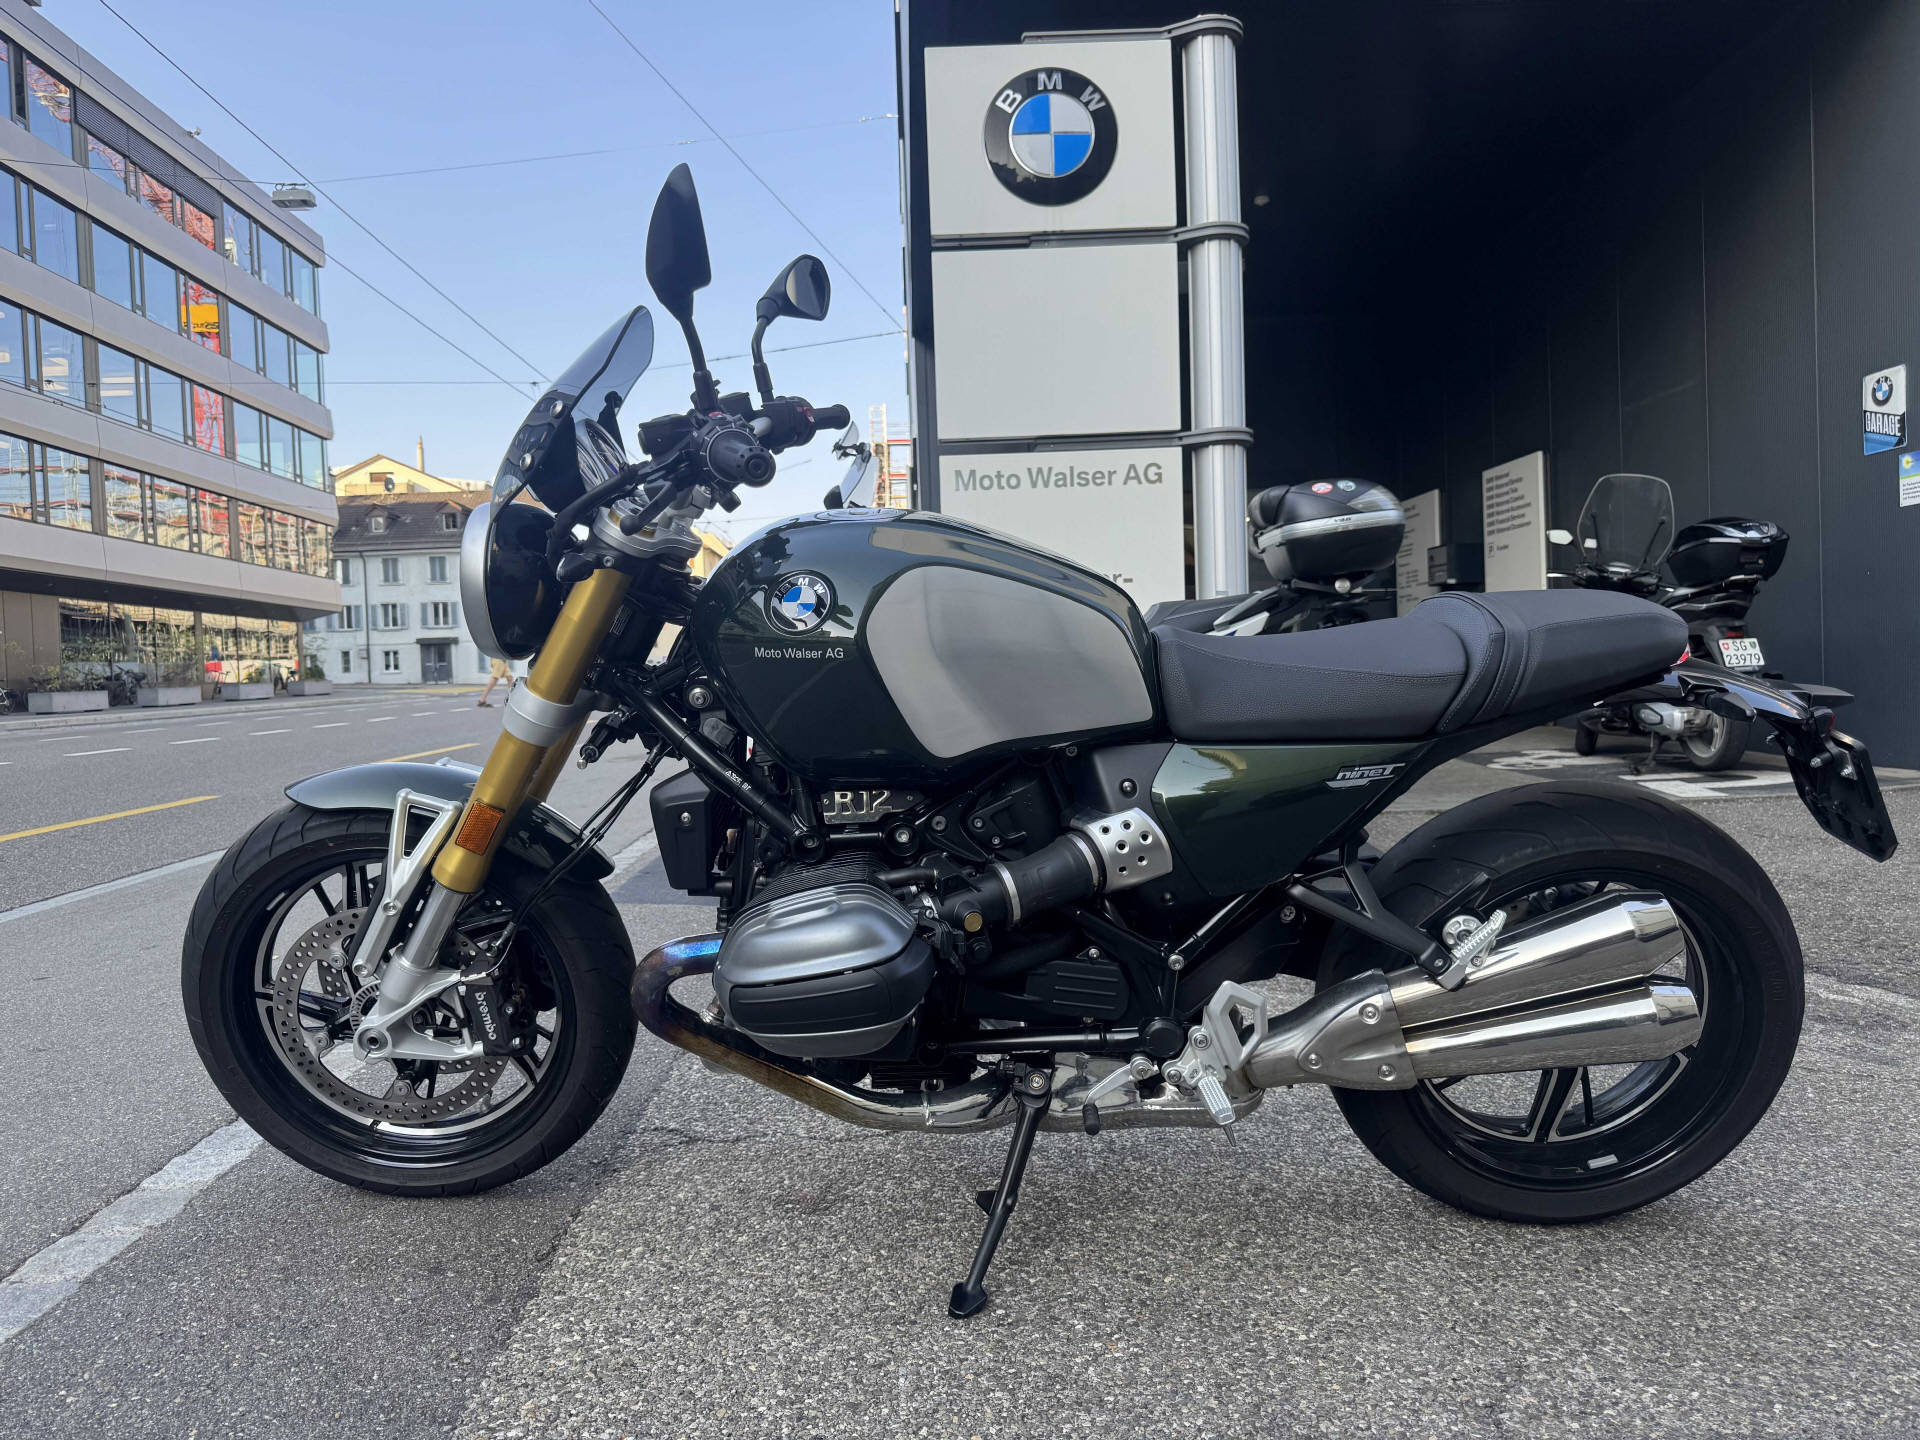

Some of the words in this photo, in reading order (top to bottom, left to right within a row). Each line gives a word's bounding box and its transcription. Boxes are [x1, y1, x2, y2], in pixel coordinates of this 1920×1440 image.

[995, 71, 1106, 113] BMW
[1865, 411, 1902, 437] GARAGE
[954, 468, 1022, 492] Moto
[1027, 465, 1117, 489] Walser
[1122, 462, 1163, 486] AG
[754, 647, 782, 659] Moto
[783, 647, 823, 659] Walser
[825, 648, 844, 659] AG
[1725, 653, 1761, 665] 23979
[1732, 640, 1748, 652] SG
[475, 991, 497, 1041] brembo
